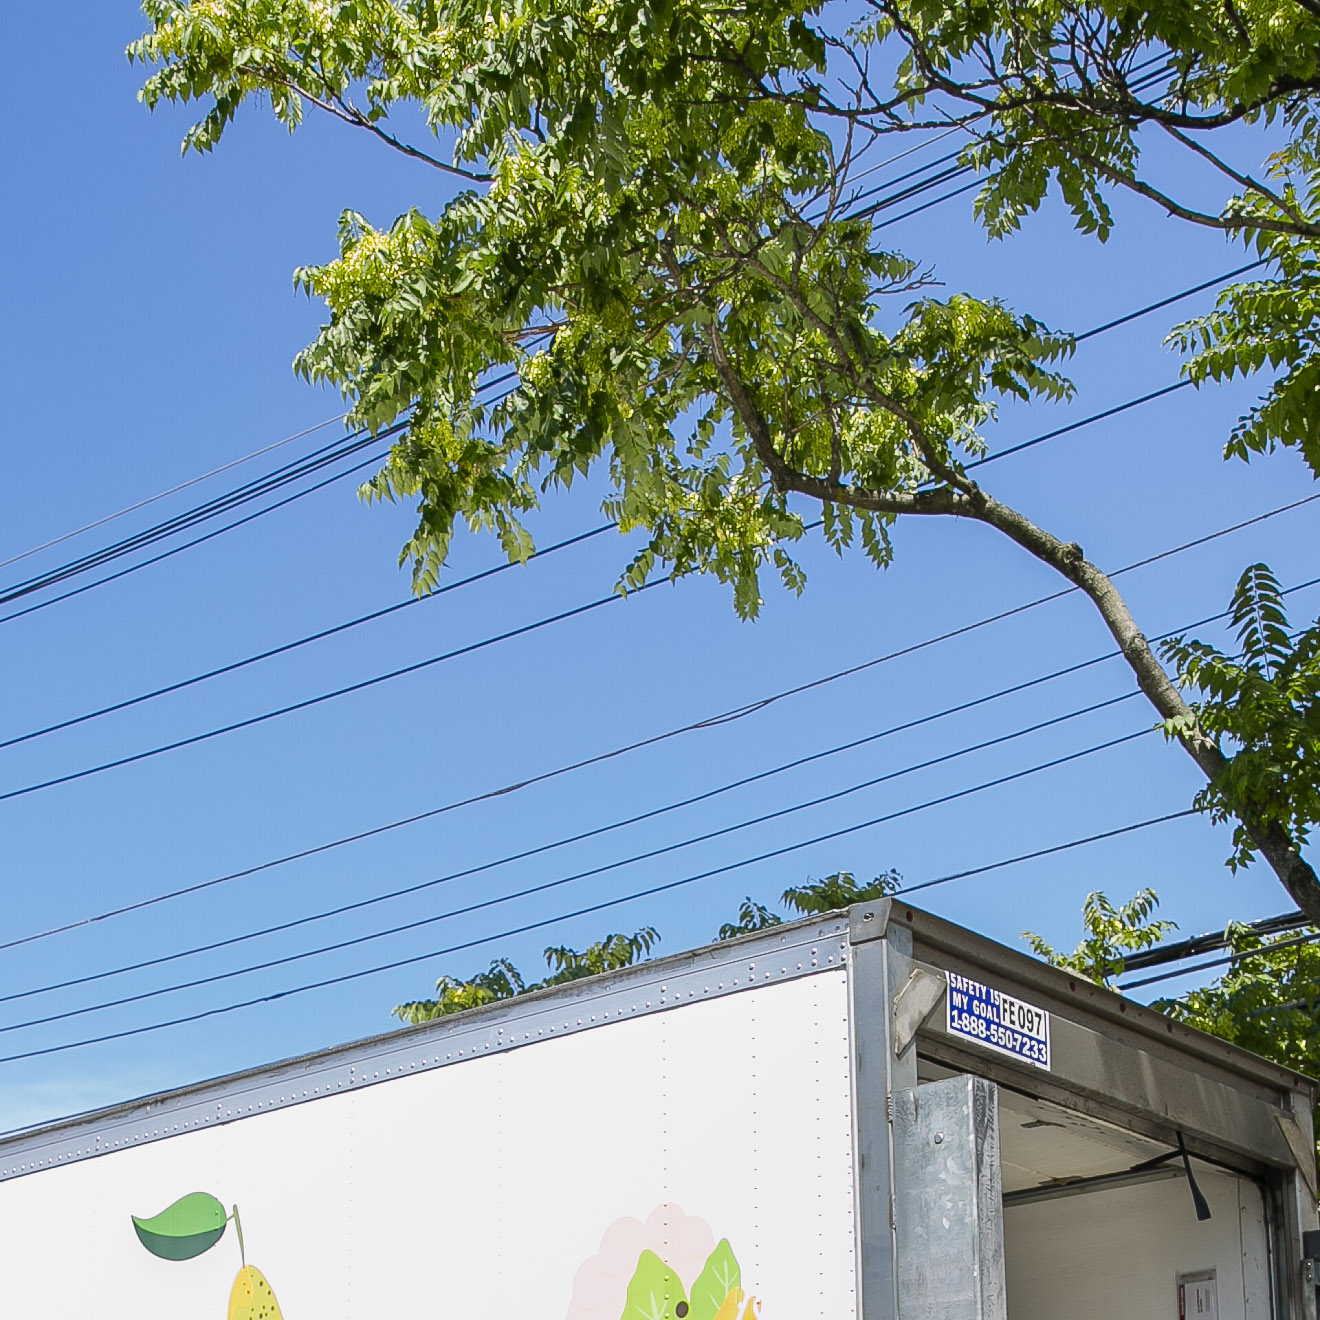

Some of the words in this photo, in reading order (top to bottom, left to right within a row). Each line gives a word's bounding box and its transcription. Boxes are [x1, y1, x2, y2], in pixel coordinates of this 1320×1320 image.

[950, 973, 987, 1000] SAFETY
[990, 989, 1000, 1006] IS
[952, 990, 968, 1010] MY
[972, 1000, 999, 1023] GOAL
[1002, 998, 1015, 1025] FE
[1018, 1005, 1042, 1036] 097
[951, 1009, 1047, 1062] 1-888-550-7233
